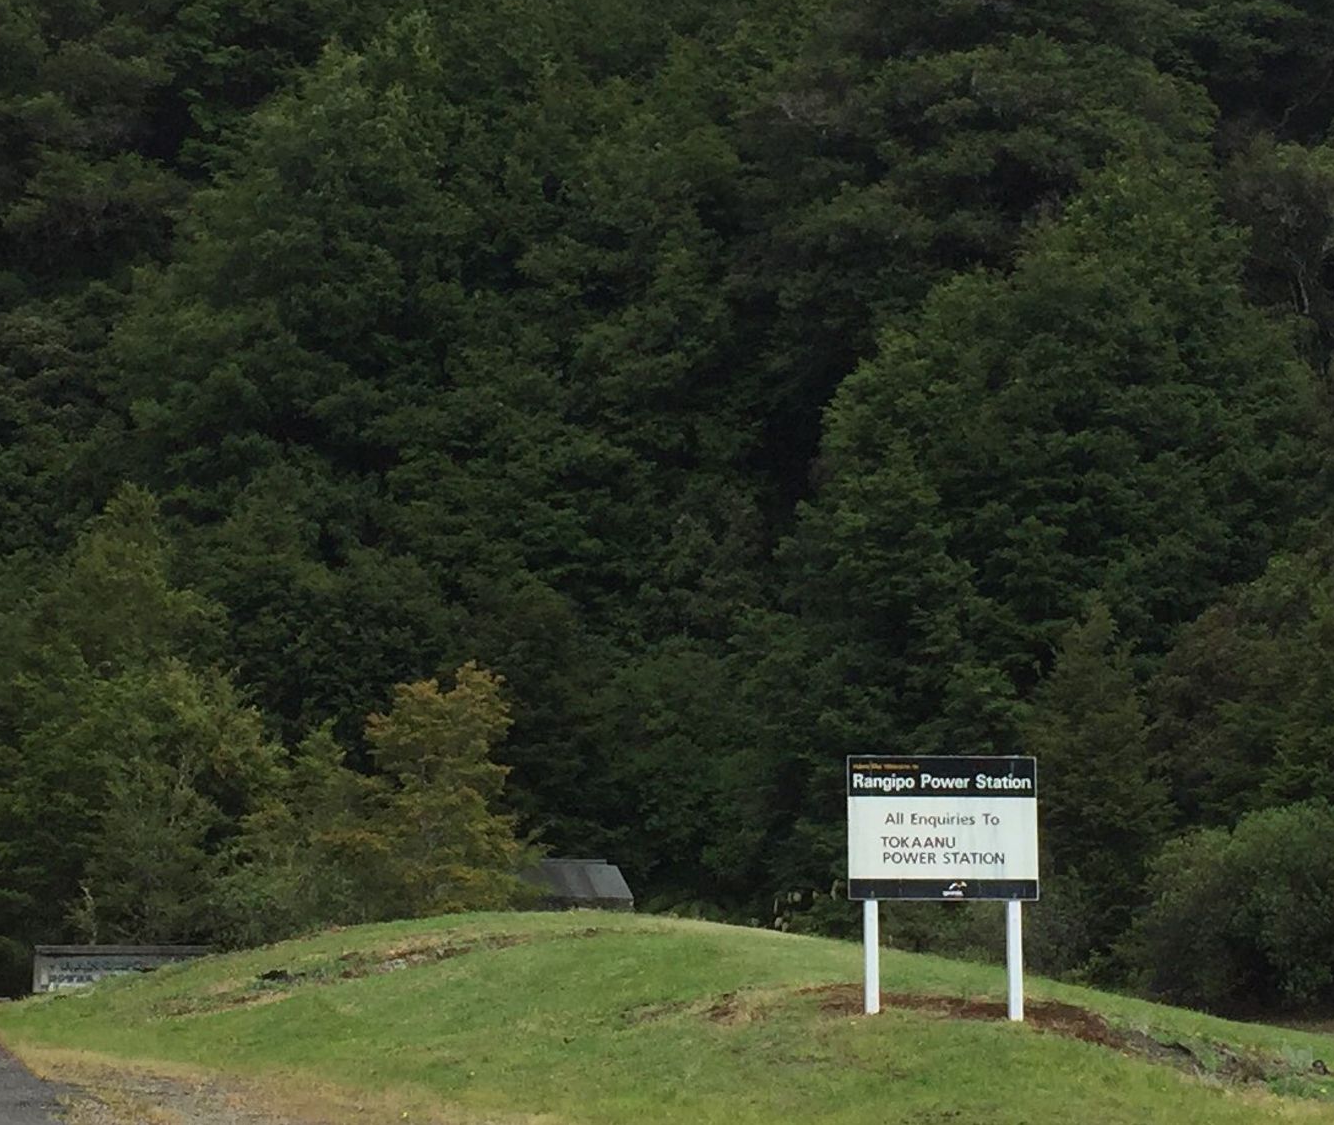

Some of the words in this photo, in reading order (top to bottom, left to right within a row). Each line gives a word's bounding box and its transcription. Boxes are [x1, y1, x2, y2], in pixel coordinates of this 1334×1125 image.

[852, 773, 915, 792] Rangipo
[920, 773, 970, 789] Power
[975, 773, 1032, 790] Station
[884, 812, 904, 825] All
[910, 812, 975, 828] Enquiries
[982, 813, 1000, 826] To
[880, 836, 956, 849] TOKAANU
[883, 852, 936, 865] POWER
[943, 852, 1005, 865] STATION
